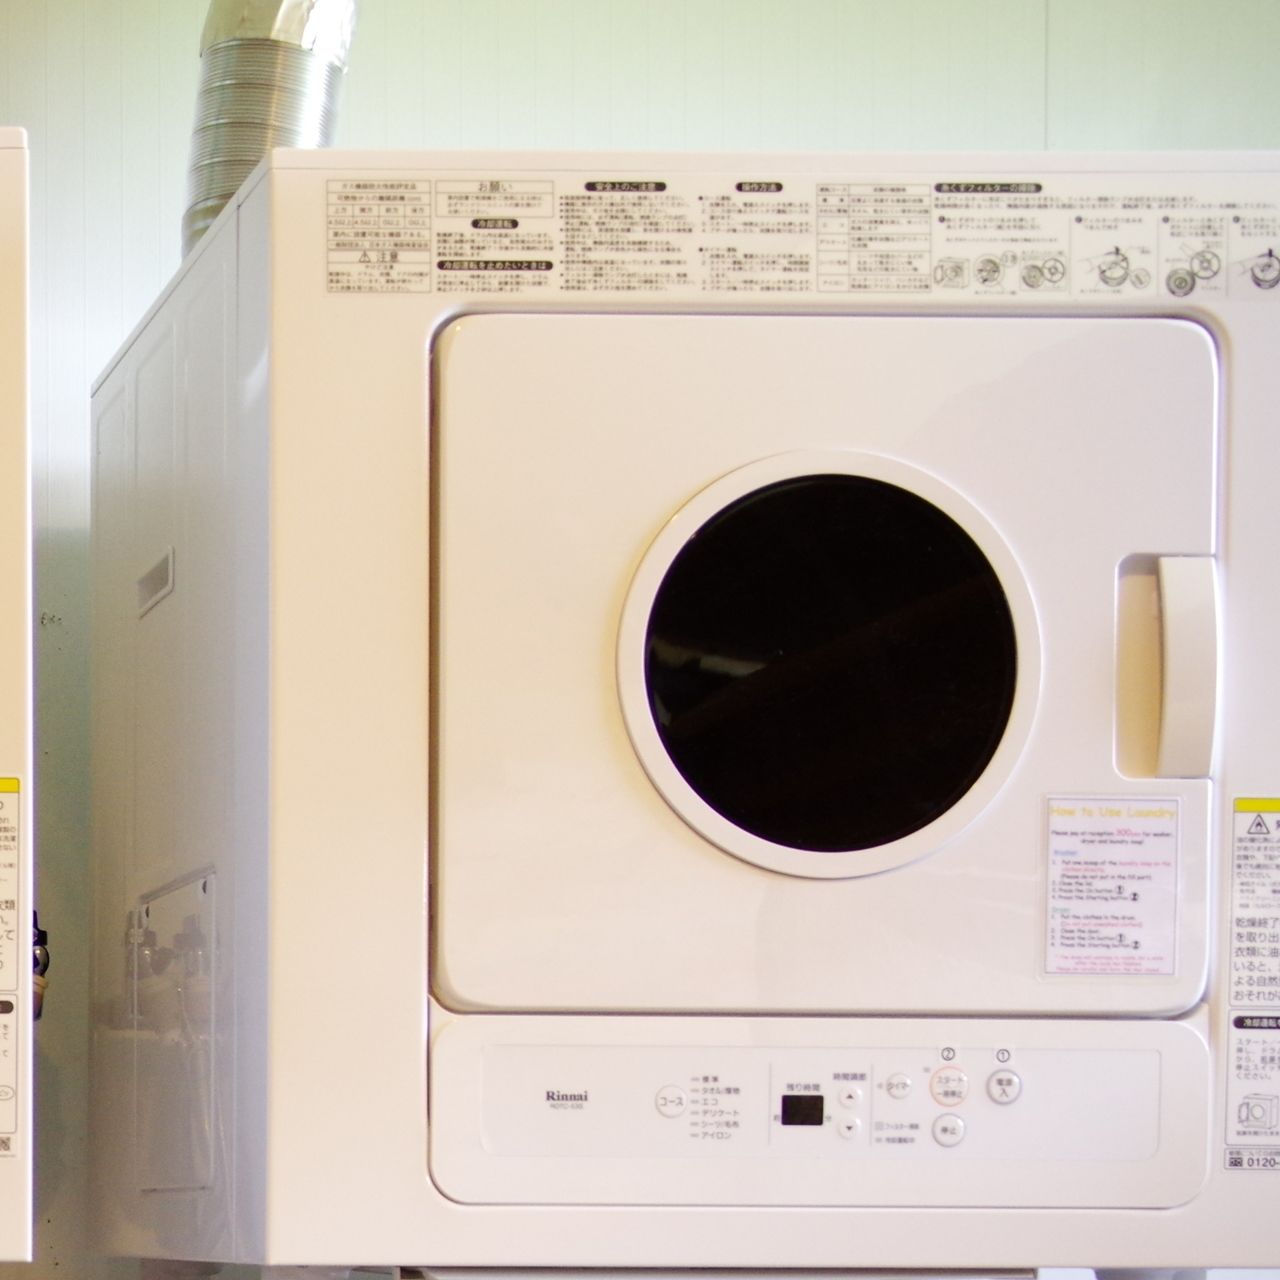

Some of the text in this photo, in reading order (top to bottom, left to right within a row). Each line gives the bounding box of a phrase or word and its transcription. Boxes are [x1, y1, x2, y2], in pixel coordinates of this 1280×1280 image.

[478, 182, 512, 191] お願い
[376, 252, 399, 262] 注意
[444, 261, 547, 270] 冷却運転を止めたいときは
[1050, 808, 1175, 819] How to Use Laundry
[546, 1091, 588, 1101] Rinnai
[937, 1090, 962, 1098] 一時停止
[999, 1088, 1008, 1097] 入
[660, 1097, 683, 1106] コース
[940, 1127, 956, 1135] 停止
